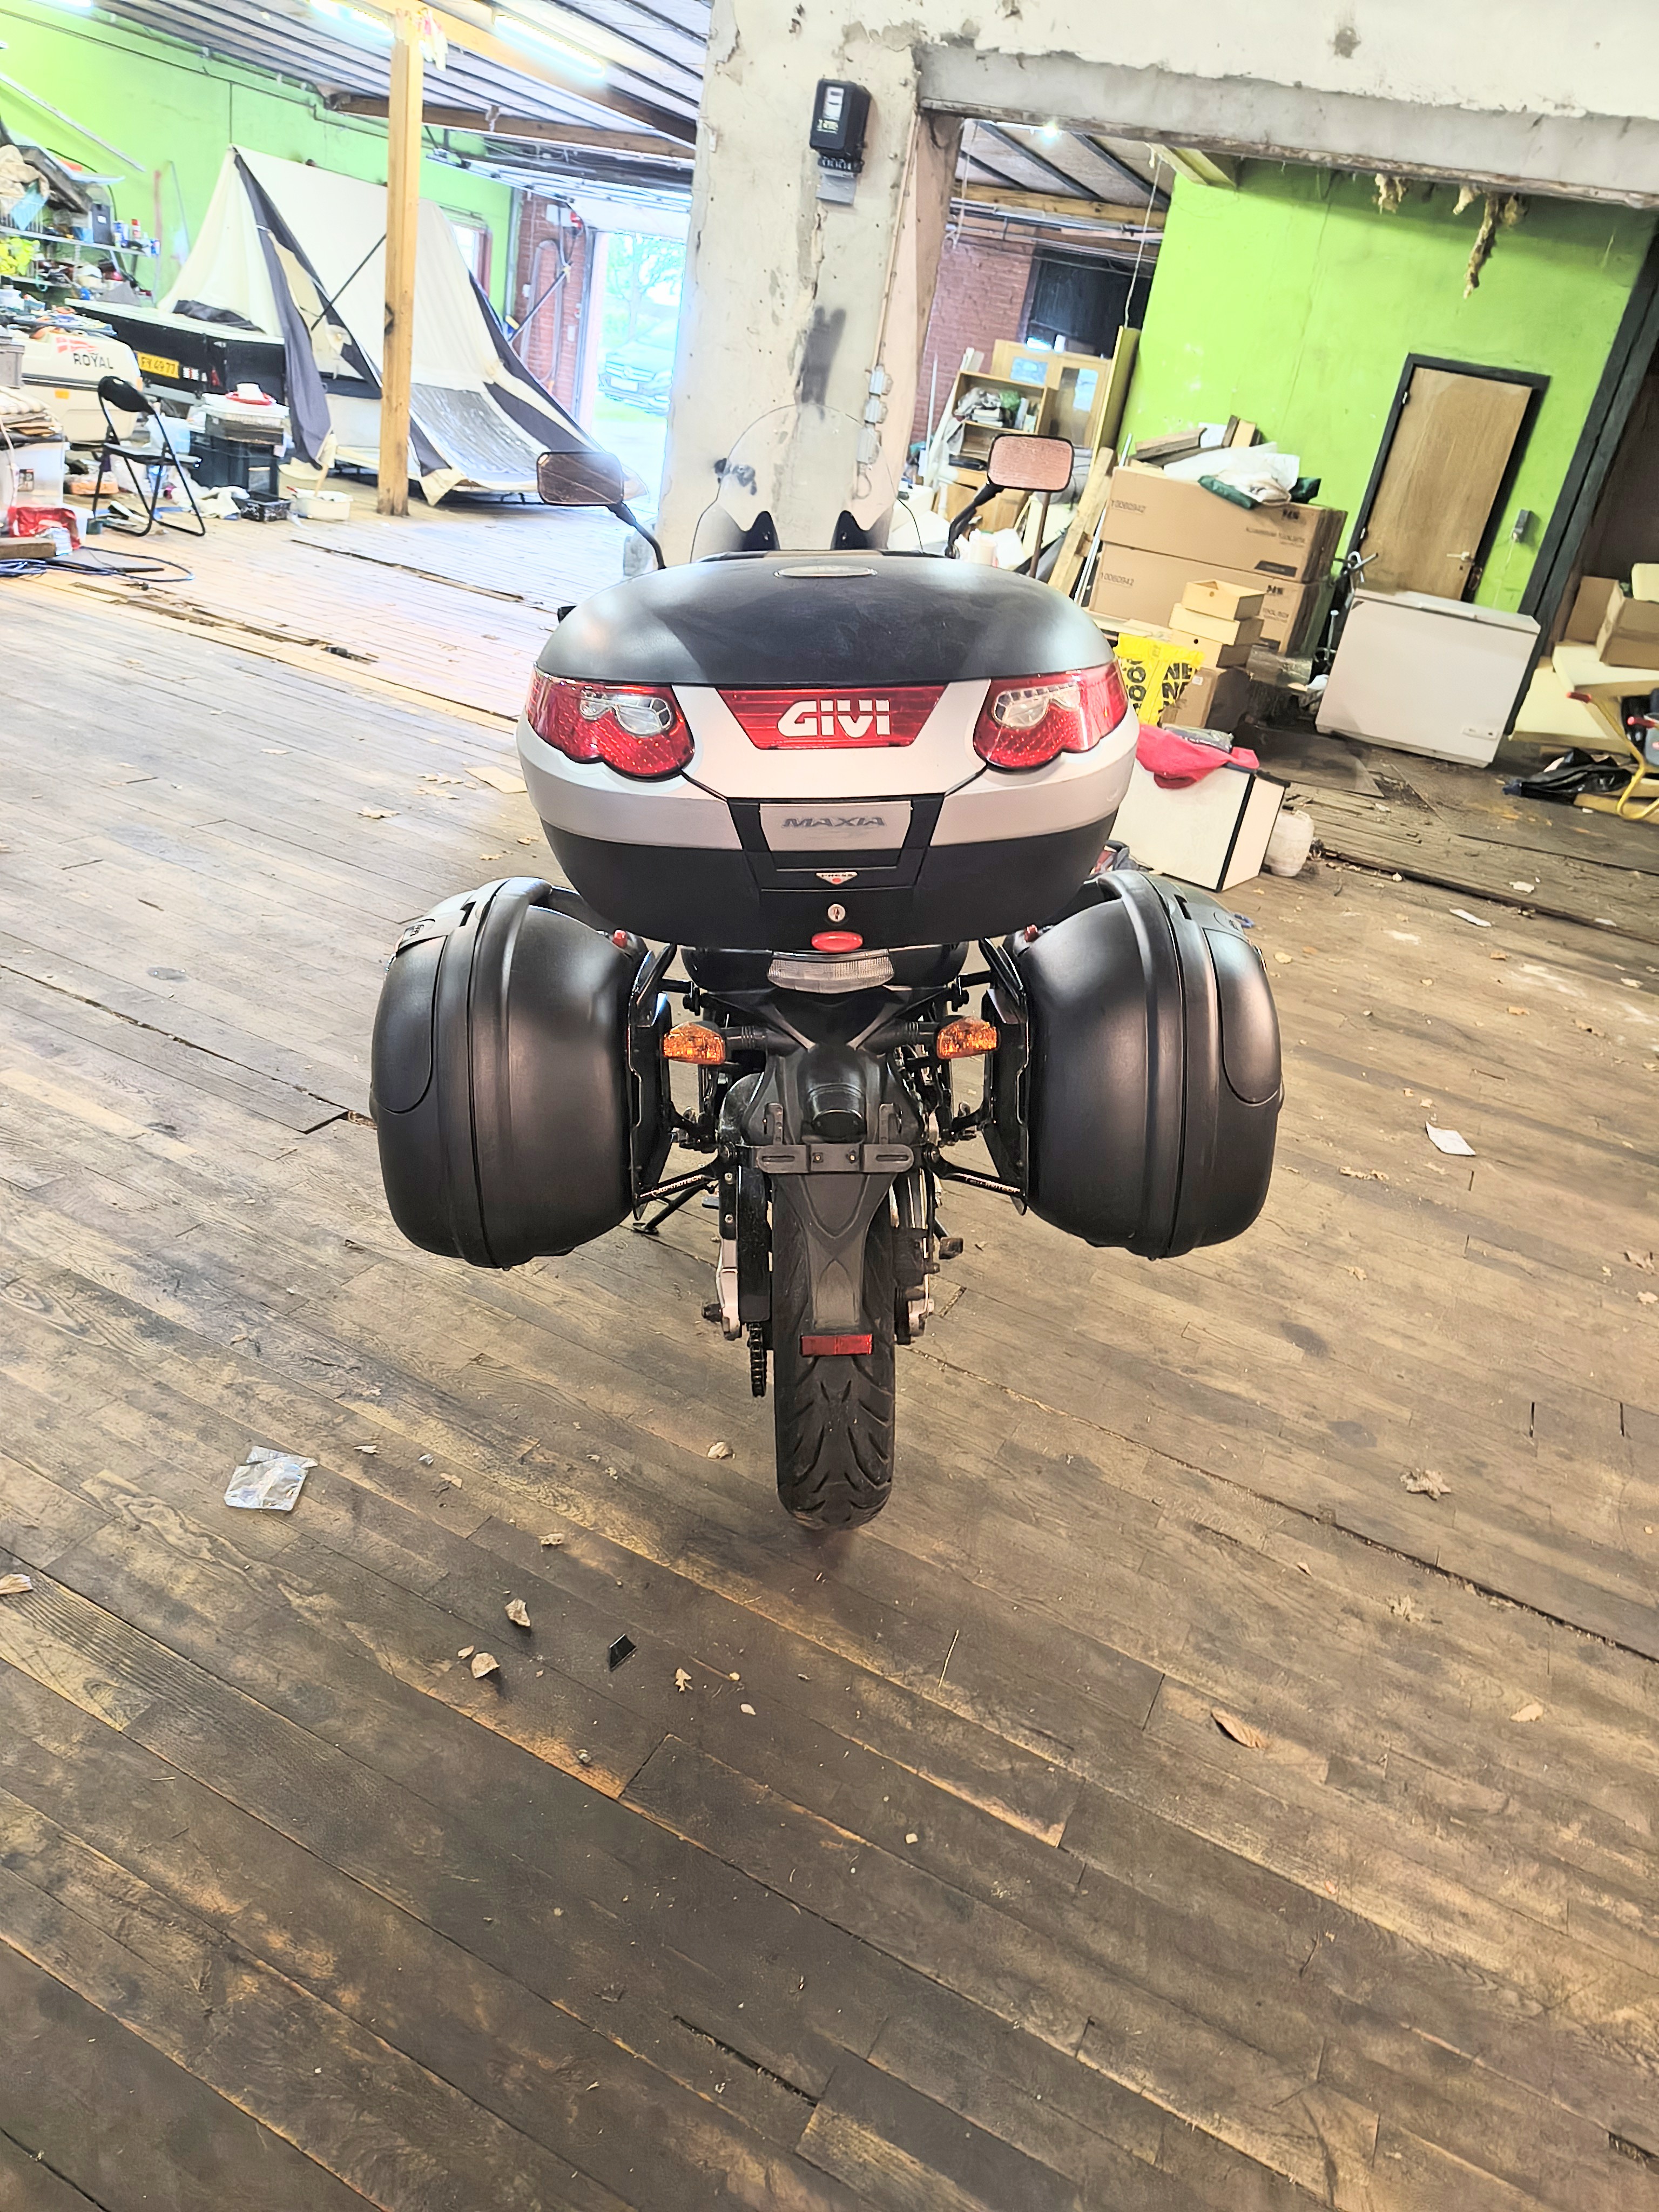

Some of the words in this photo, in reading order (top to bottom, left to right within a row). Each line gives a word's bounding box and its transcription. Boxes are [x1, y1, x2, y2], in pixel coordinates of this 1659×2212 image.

[73, 353, 114, 369] ROYAL
[777, 699, 891, 738] GIVI
[783, 817, 886, 828] MAXIA
